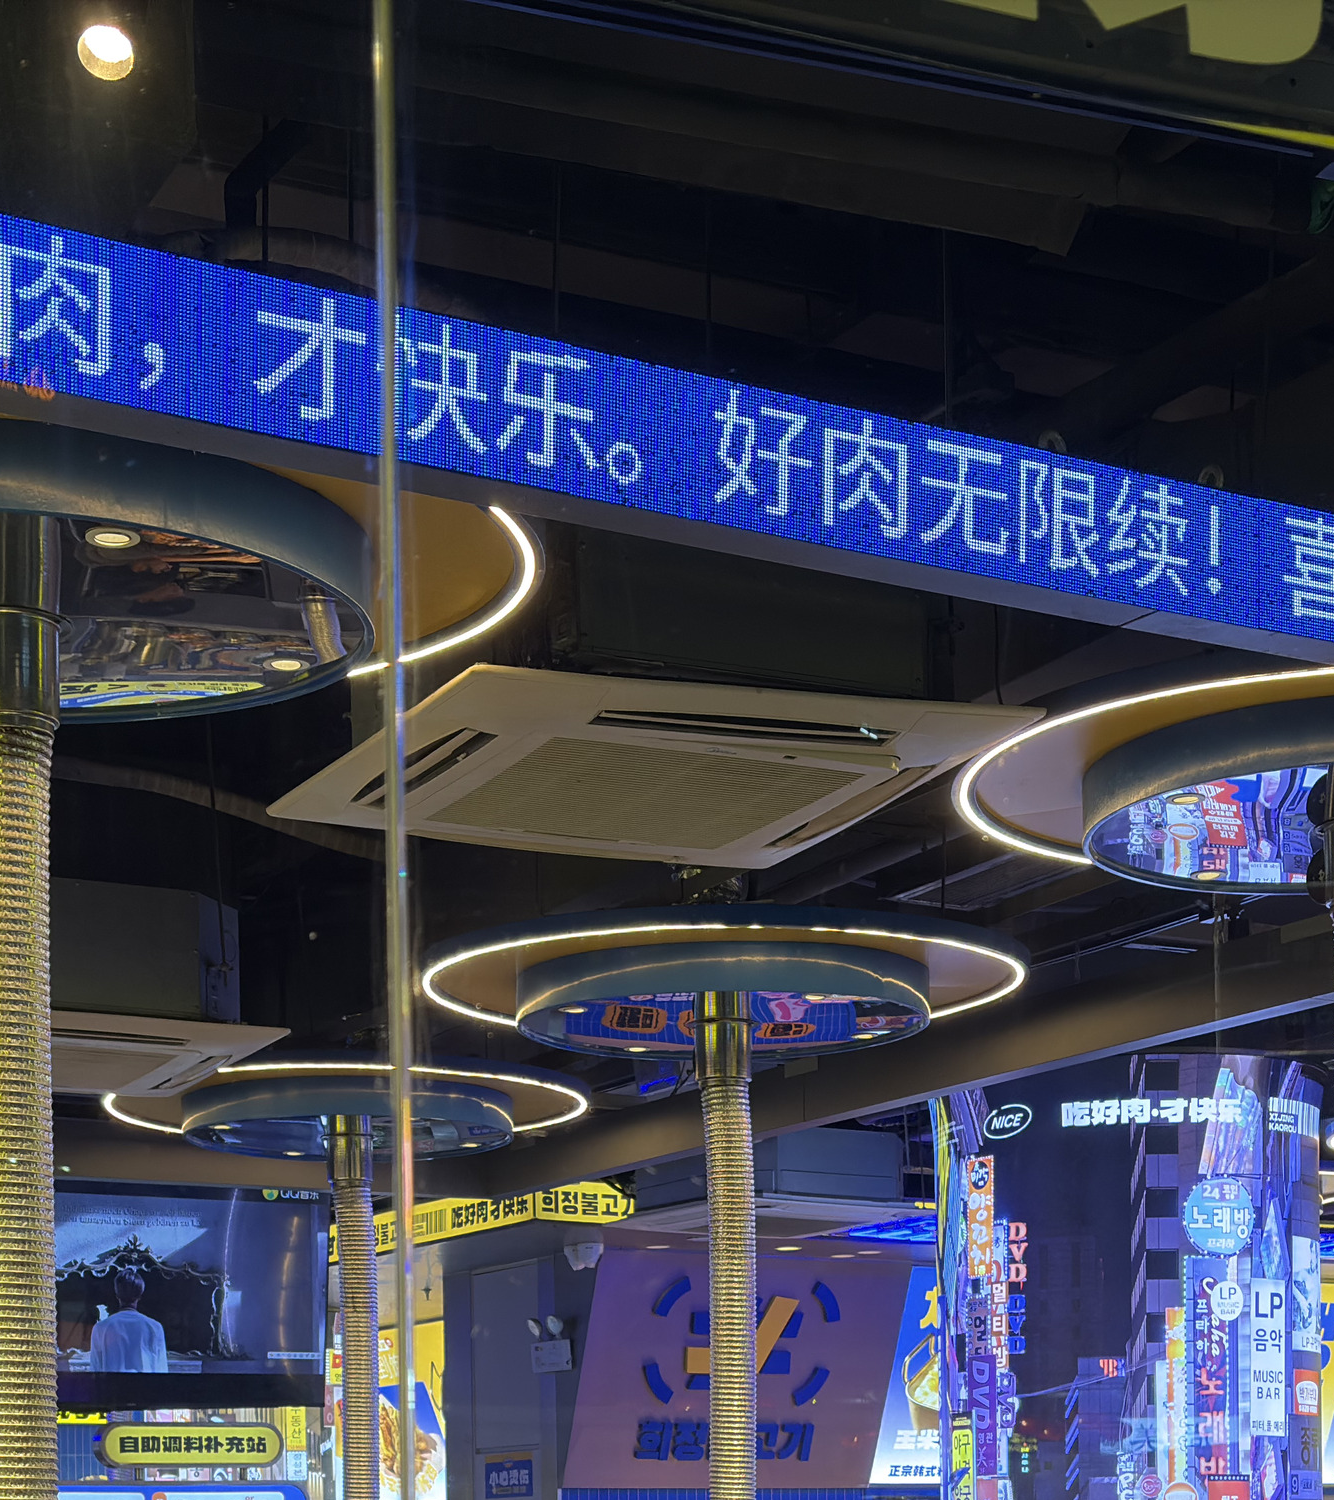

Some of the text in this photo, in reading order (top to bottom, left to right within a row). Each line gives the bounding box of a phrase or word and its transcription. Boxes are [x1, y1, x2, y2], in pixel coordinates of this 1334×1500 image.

[991, 1113, 1022, 1131] NICE
[1202, 1184, 1220, 1200] 24
[1189, 1206, 1250, 1239] 노래방
[1009, 1222, 1027, 1282] DVD
[1219, 1287, 1237, 1300] LP
[1254, 1292, 1283, 1320] LP
[1009, 1295, 1026, 1354] DVD
[1253, 1328, 1283, 1353] 음악
[1253, 1370, 1284, 1385] MUSIC
[1257, 1386, 1281, 1400] BAR
[119, 1436, 267, 1454] 自助调料补充站
